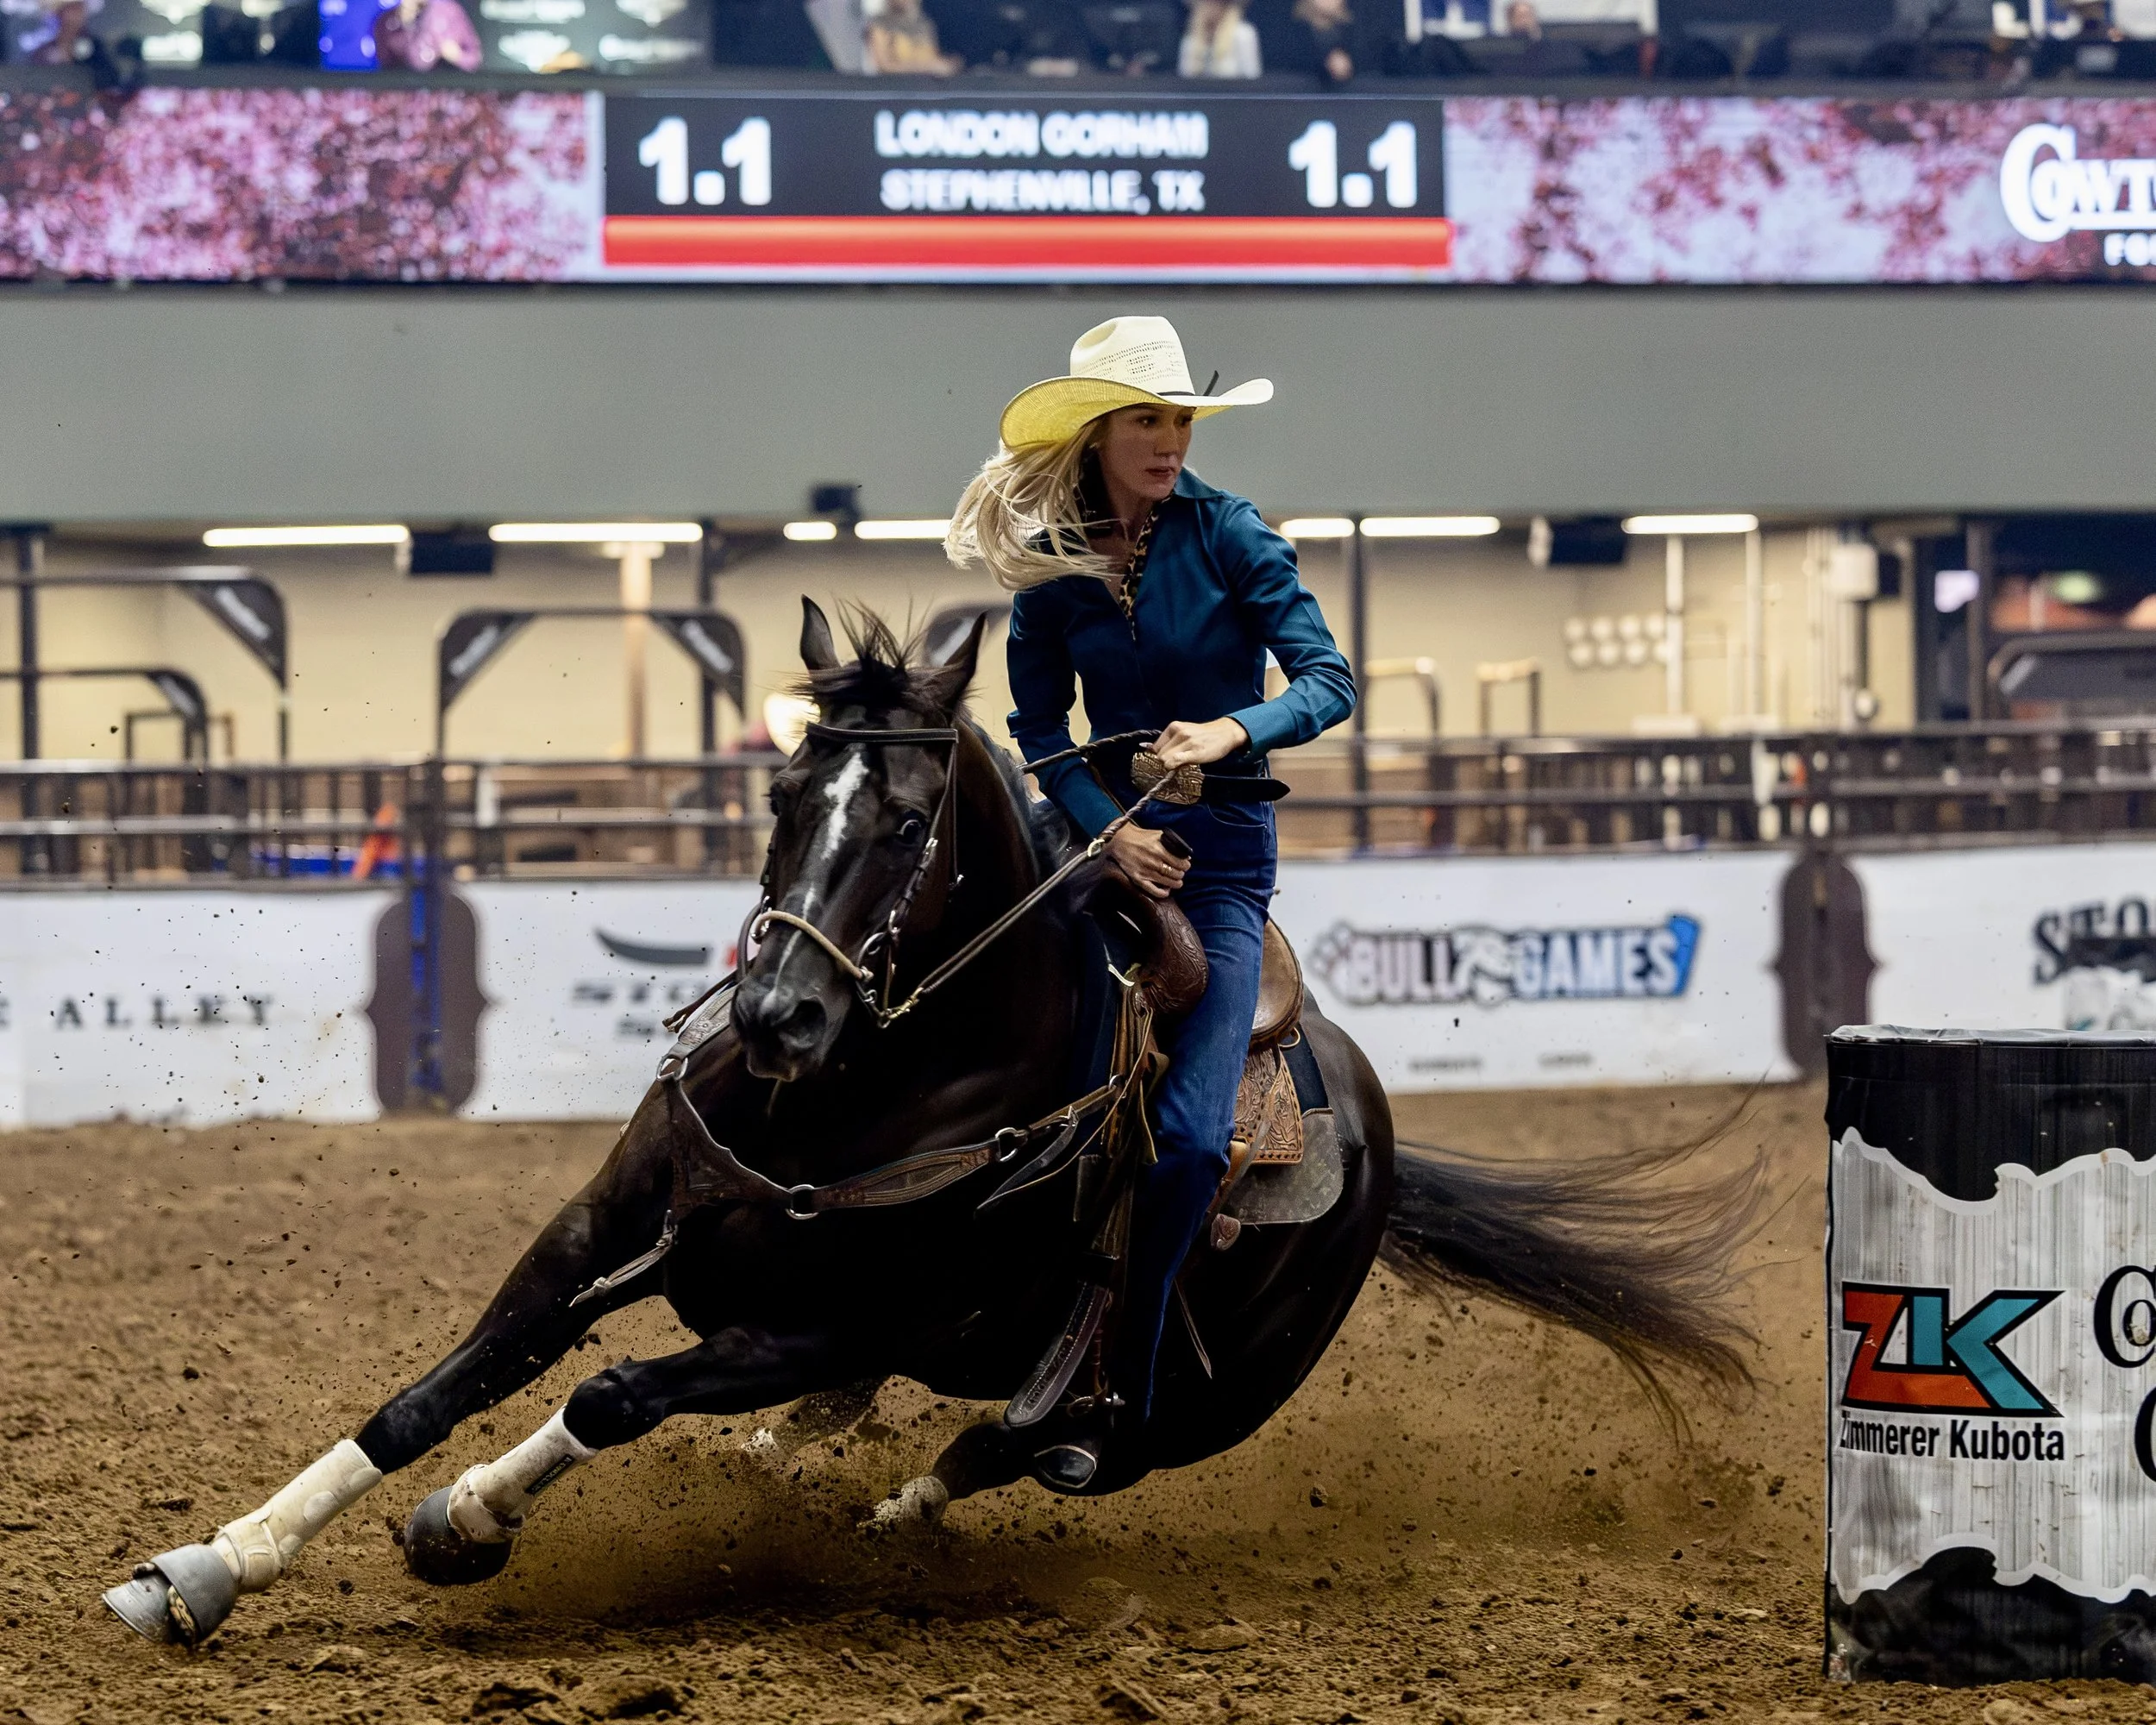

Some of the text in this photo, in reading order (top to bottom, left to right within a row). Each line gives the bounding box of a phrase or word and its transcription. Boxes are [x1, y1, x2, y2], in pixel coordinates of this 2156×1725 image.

[874, 110, 1040, 159] LONDON
[638, 116, 772, 206] 1.1
[1288, 120, 1418, 209] 1.1
[2000, 122, 2156, 242] COWT
[1151, 169, 1206, 212] TX
[2103, 232, 2156, 266] FO
[1509, 929, 1681, 997] GAMES
[54, 995, 273, 1030] ALLEY
[1839, 1409, 2065, 1461] Zimmerer Kubota
